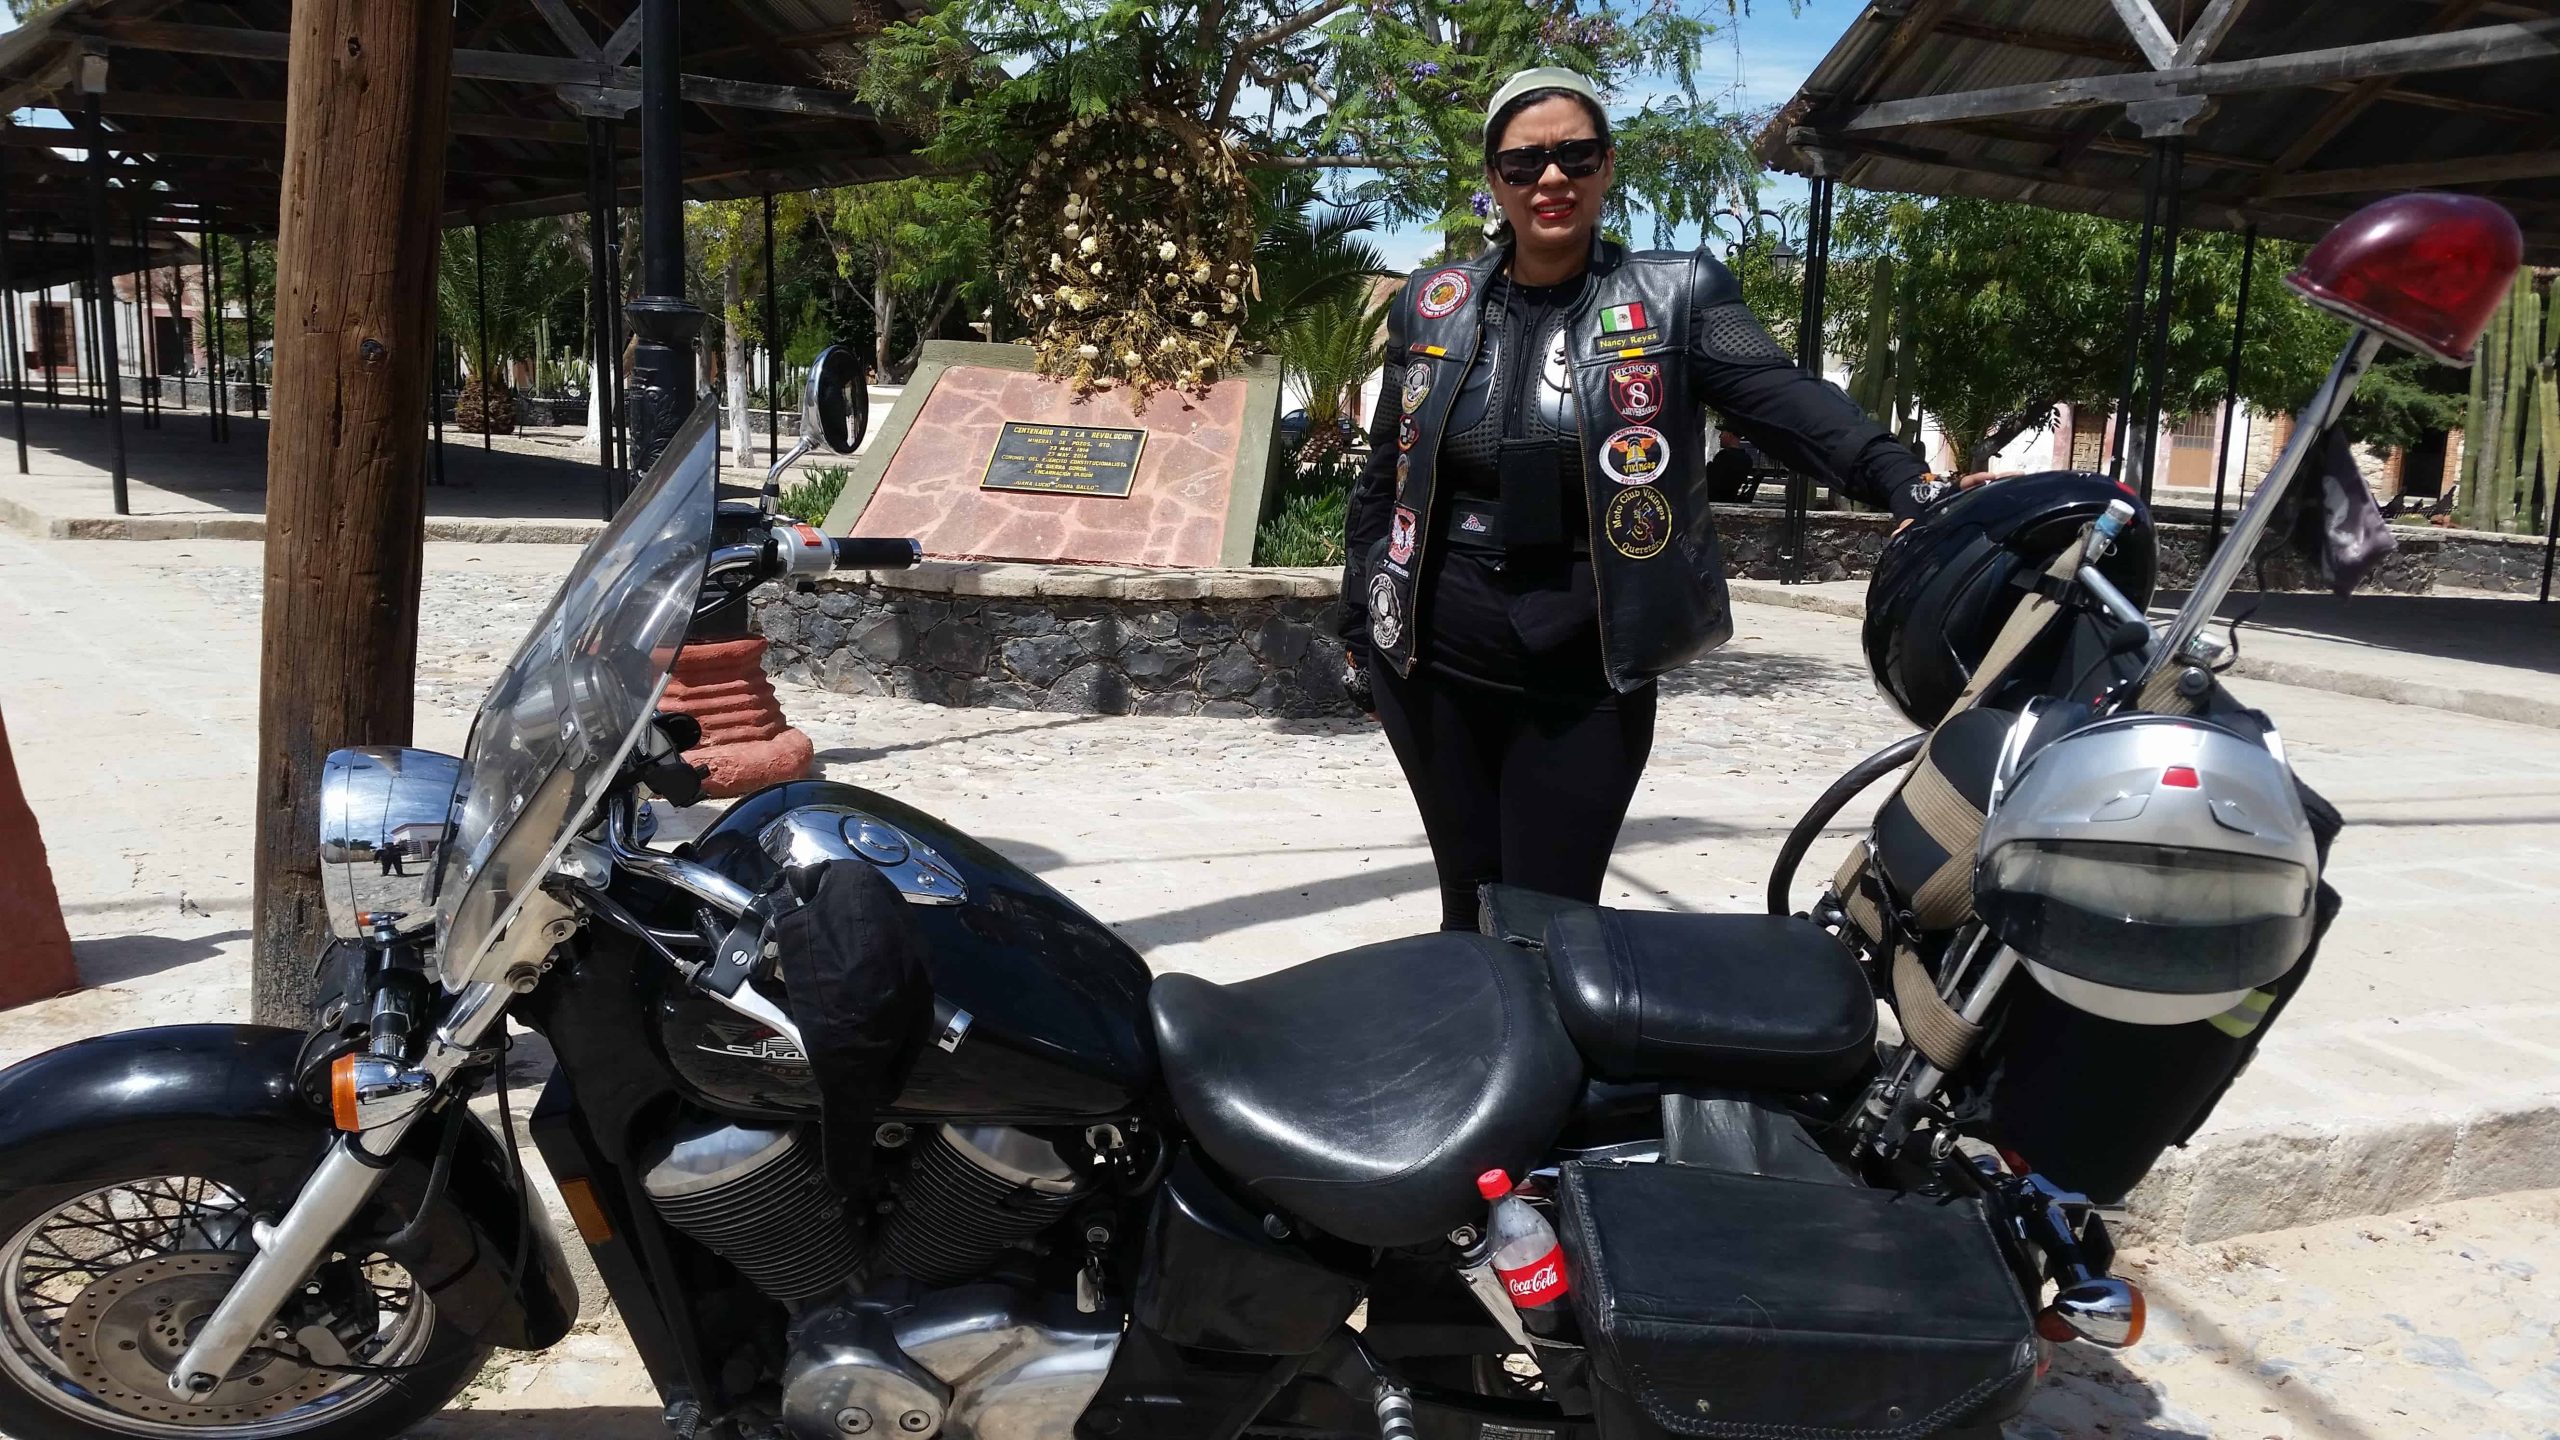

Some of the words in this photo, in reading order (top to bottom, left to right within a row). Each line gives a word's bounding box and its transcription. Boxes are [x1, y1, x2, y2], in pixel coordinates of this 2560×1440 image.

[1599, 338, 1627, 348] Nancy
[1630, 332, 1657, 345] Reyes
[1611, 364, 1657, 377] VIKINGOS
[1627, 382, 1649, 408] 8
[1013, 426, 1054, 436] CENTENARIO
[1612, 504, 1623, 530] Moto
[1619, 488, 1641, 504] Club
[1643, 488, 1666, 521] Vikingos
[697, 1041, 806, 1060] Sha
[1509, 1261, 1558, 1296] Coca-Cola
